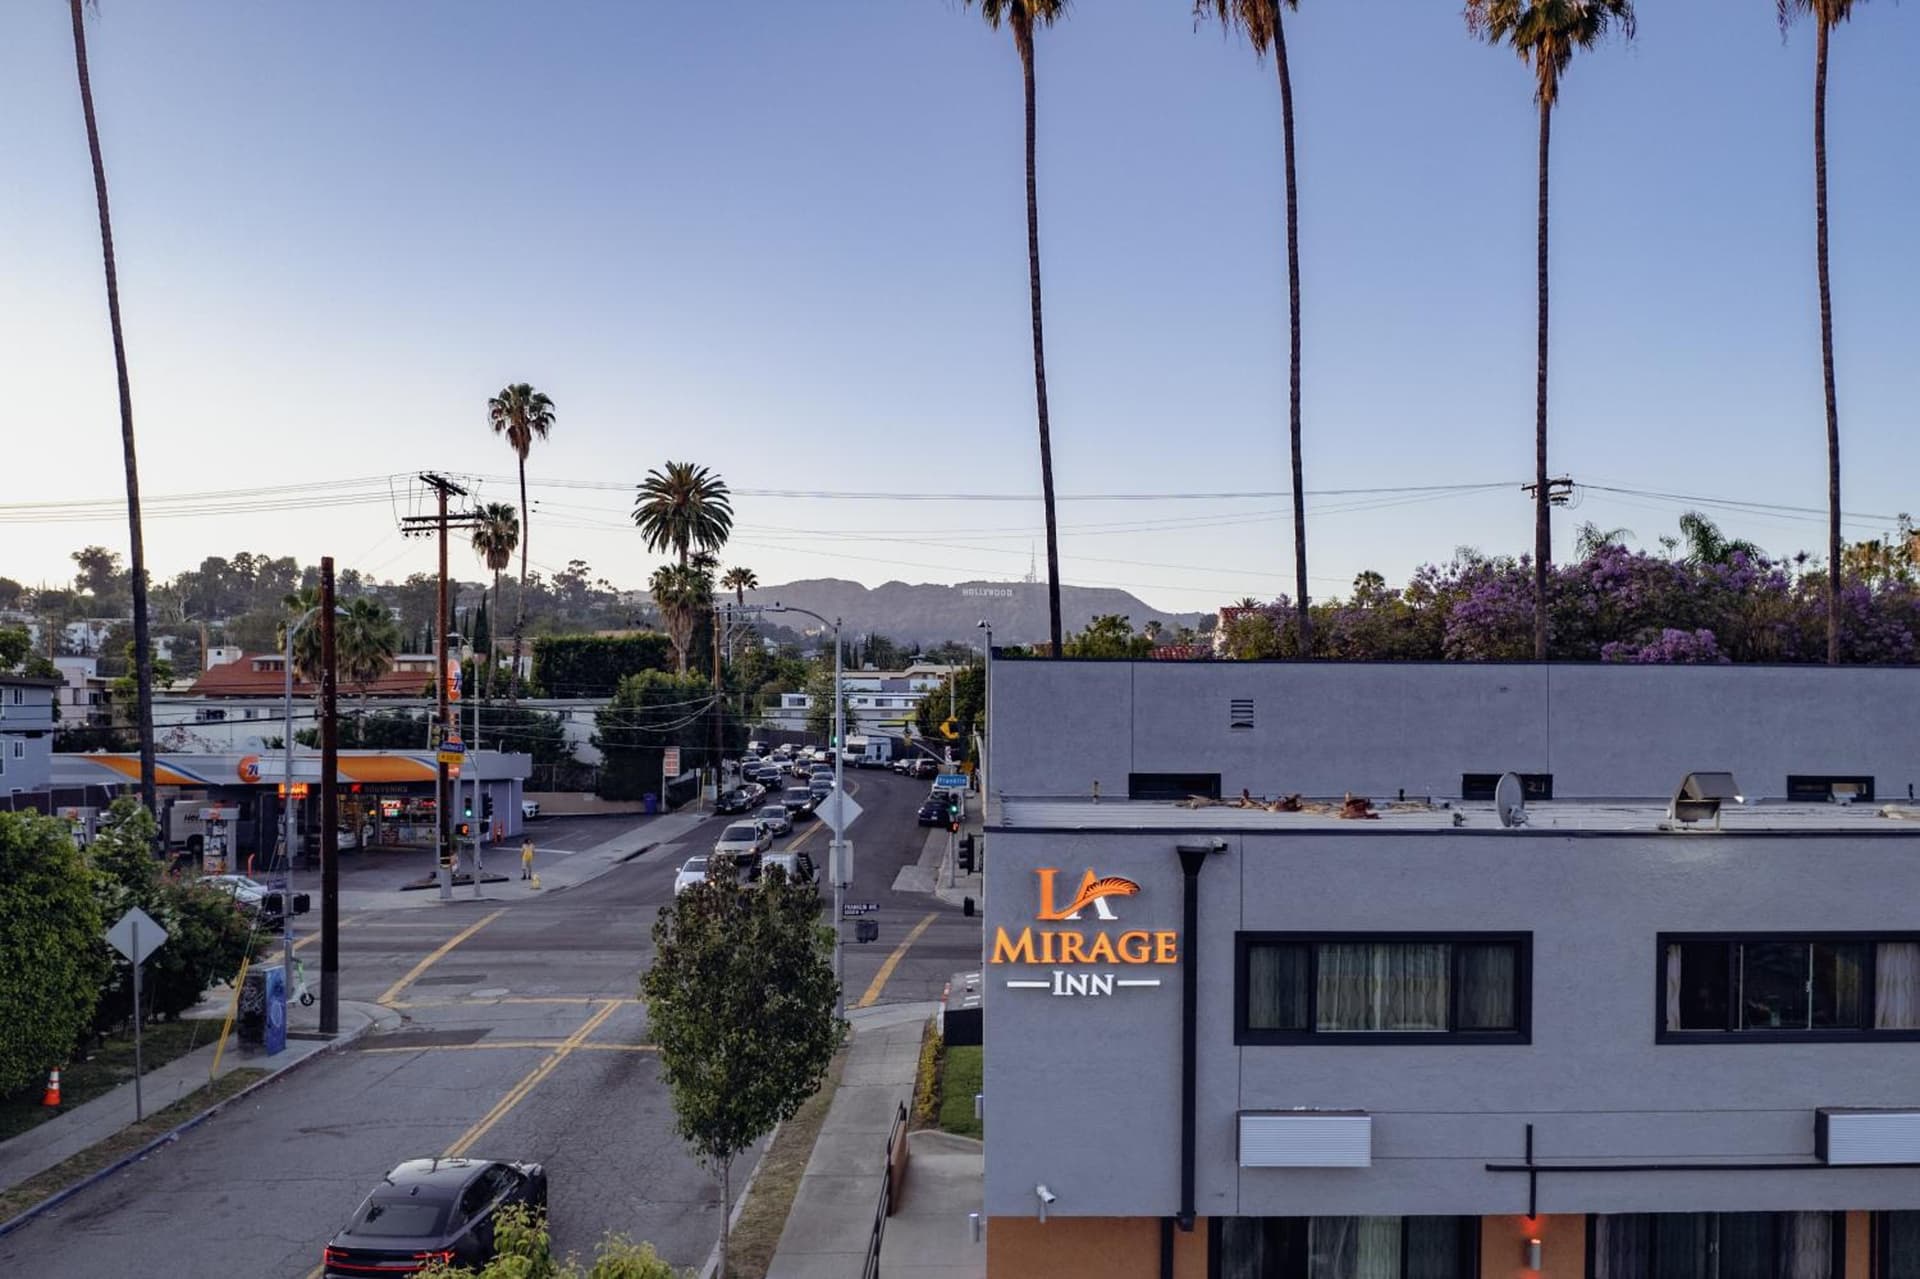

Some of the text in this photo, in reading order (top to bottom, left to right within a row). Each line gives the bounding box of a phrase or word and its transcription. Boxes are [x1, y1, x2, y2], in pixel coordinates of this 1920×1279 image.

[962, 588, 1013, 597] HOLLYWOOD
[939, 777, 966, 785] Franklin
[1034, 867, 1120, 921] LA
[990, 926, 1178, 965] MIRAGE
[1052, 970, 1115, 996] INN
